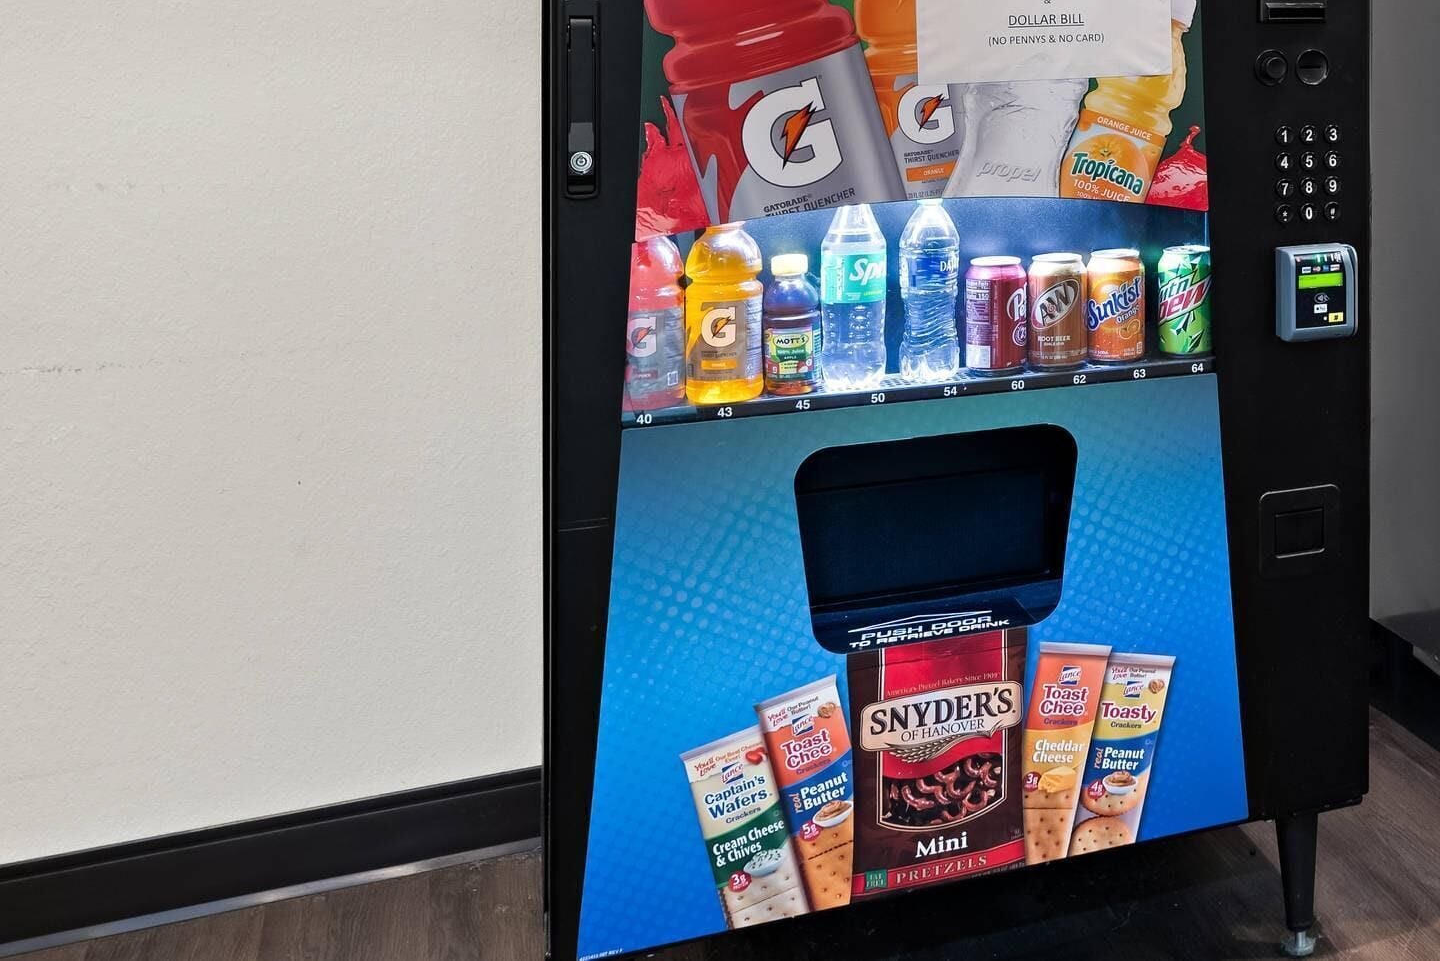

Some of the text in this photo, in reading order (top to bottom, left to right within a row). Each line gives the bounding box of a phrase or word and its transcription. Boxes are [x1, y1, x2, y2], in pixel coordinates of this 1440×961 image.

[1008, 12, 1085, 26] DOLLAR BILL
[988, 32, 1105, 48] (NO PENNYS & NO CARD)
[896, 83, 956, 145] G
[742, 76, 844, 189] G
[1096, 115, 1153, 141] ORANGE JUICE
[1282, 127, 1338, 143] 1 2 3
[904, 149, 960, 164] THIRST QUENCHER
[1280, 154, 1337, 169] 4 5 6
[923, 167, 945, 177] ORANGE
[976, 160, 1042, 183] propel
[1070, 151, 1144, 196] Tropicana
[1072, 177, 1130, 203] 100% JUICE
[1281, 179, 1337, 196] 7 8 9
[763, 194, 808, 214] GATORADE
[803, 187, 856, 212] QUENCHER
[1305, 206, 1313, 220] 0
[1087, 276, 1142, 331] Sunkist
[1117, 304, 1141, 324] orange
[701, 305, 736, 348] G
[1132, 368, 1147, 379] 63
[1191, 362, 1205, 374] 64
[1010, 379, 1025, 391] 60
[1072, 373, 1087, 385] 62
[870, 392, 886, 404] 50
[943, 385, 957, 397] 54
[717, 406, 733, 418] 43
[795, 399, 811, 411] 45
[636, 413, 652, 425] 40
[849, 619, 1010, 648] TO RETRIEVE DRINK
[860, 615, 992, 641] PUSH DOOR
[941, 677, 963, 688] Bakery
[964, 674, 982, 682] Since
[1059, 669, 1081, 682] Lance
[1043, 684, 1088, 702] Toast
[870, 687, 1013, 736] SNYDER'S
[1040, 700, 1084, 715] Chee
[1101, 702, 1157, 723] Toasty
[772, 714, 788, 727] Love
[792, 715, 813, 735] Lance
[1110, 721, 1142, 729] Crackers
[900, 717, 985, 743] OF HANOVER
[782, 729, 829, 756] Toast
[1035, 739, 1084, 752] Cheddar
[786, 744, 832, 769] Chee
[1032, 750, 1074, 764] Cheese
[1104, 746, 1145, 760] Peanut
[694, 756, 715, 771] You'll
[700, 764, 716, 777] Love
[1101, 758, 1139, 771] Butter
[720, 764, 743, 784] Lance
[704, 775, 766, 806] Captain's
[801, 771, 848, 799] Peanut
[708, 788, 768, 821] Wafers
[803, 785, 846, 811] Butter
[726, 806, 762, 825] Crackers
[713, 819, 785, 857] Cream Cheese
[801, 824, 817, 835] 5g
[915, 830, 969, 858] Mini
[715, 841, 762, 868] & Chives
[869, 872, 883, 880] FAT
[895, 854, 988, 884] PRETZELS
[731, 873, 747, 885] 3g
